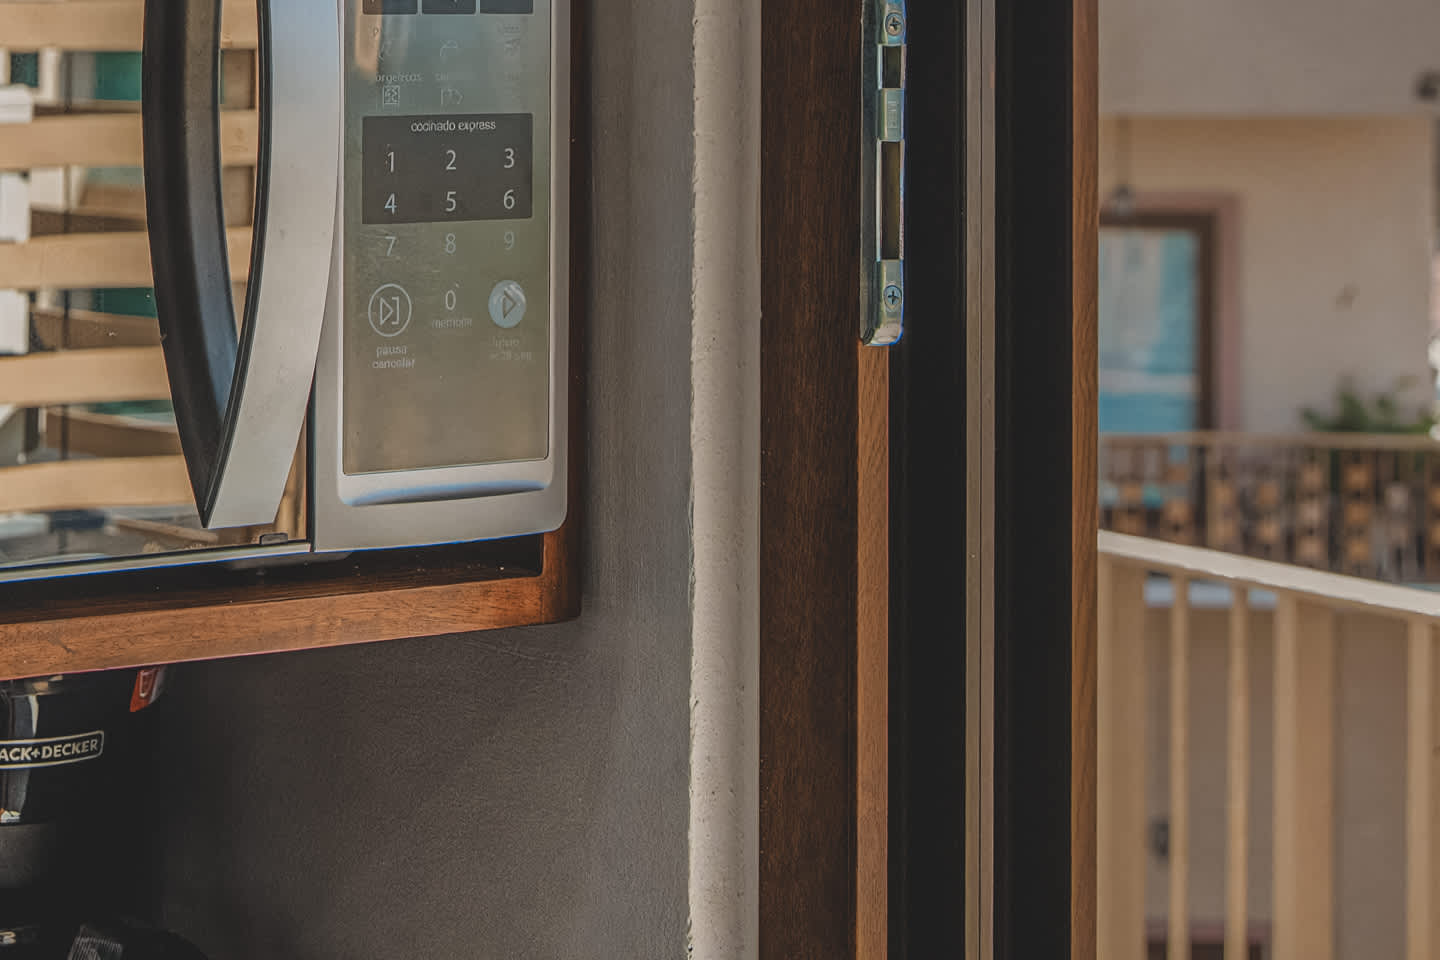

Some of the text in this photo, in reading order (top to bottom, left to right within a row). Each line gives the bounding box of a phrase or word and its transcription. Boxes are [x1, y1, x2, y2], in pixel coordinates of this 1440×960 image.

[410, 119, 496, 133] cocinado express
[387, 148, 516, 173] 1 2 3
[384, 189, 516, 215] 4 5 6
[384, 230, 515, 257] 7 8 9
[445, 289, 457, 311] 0
